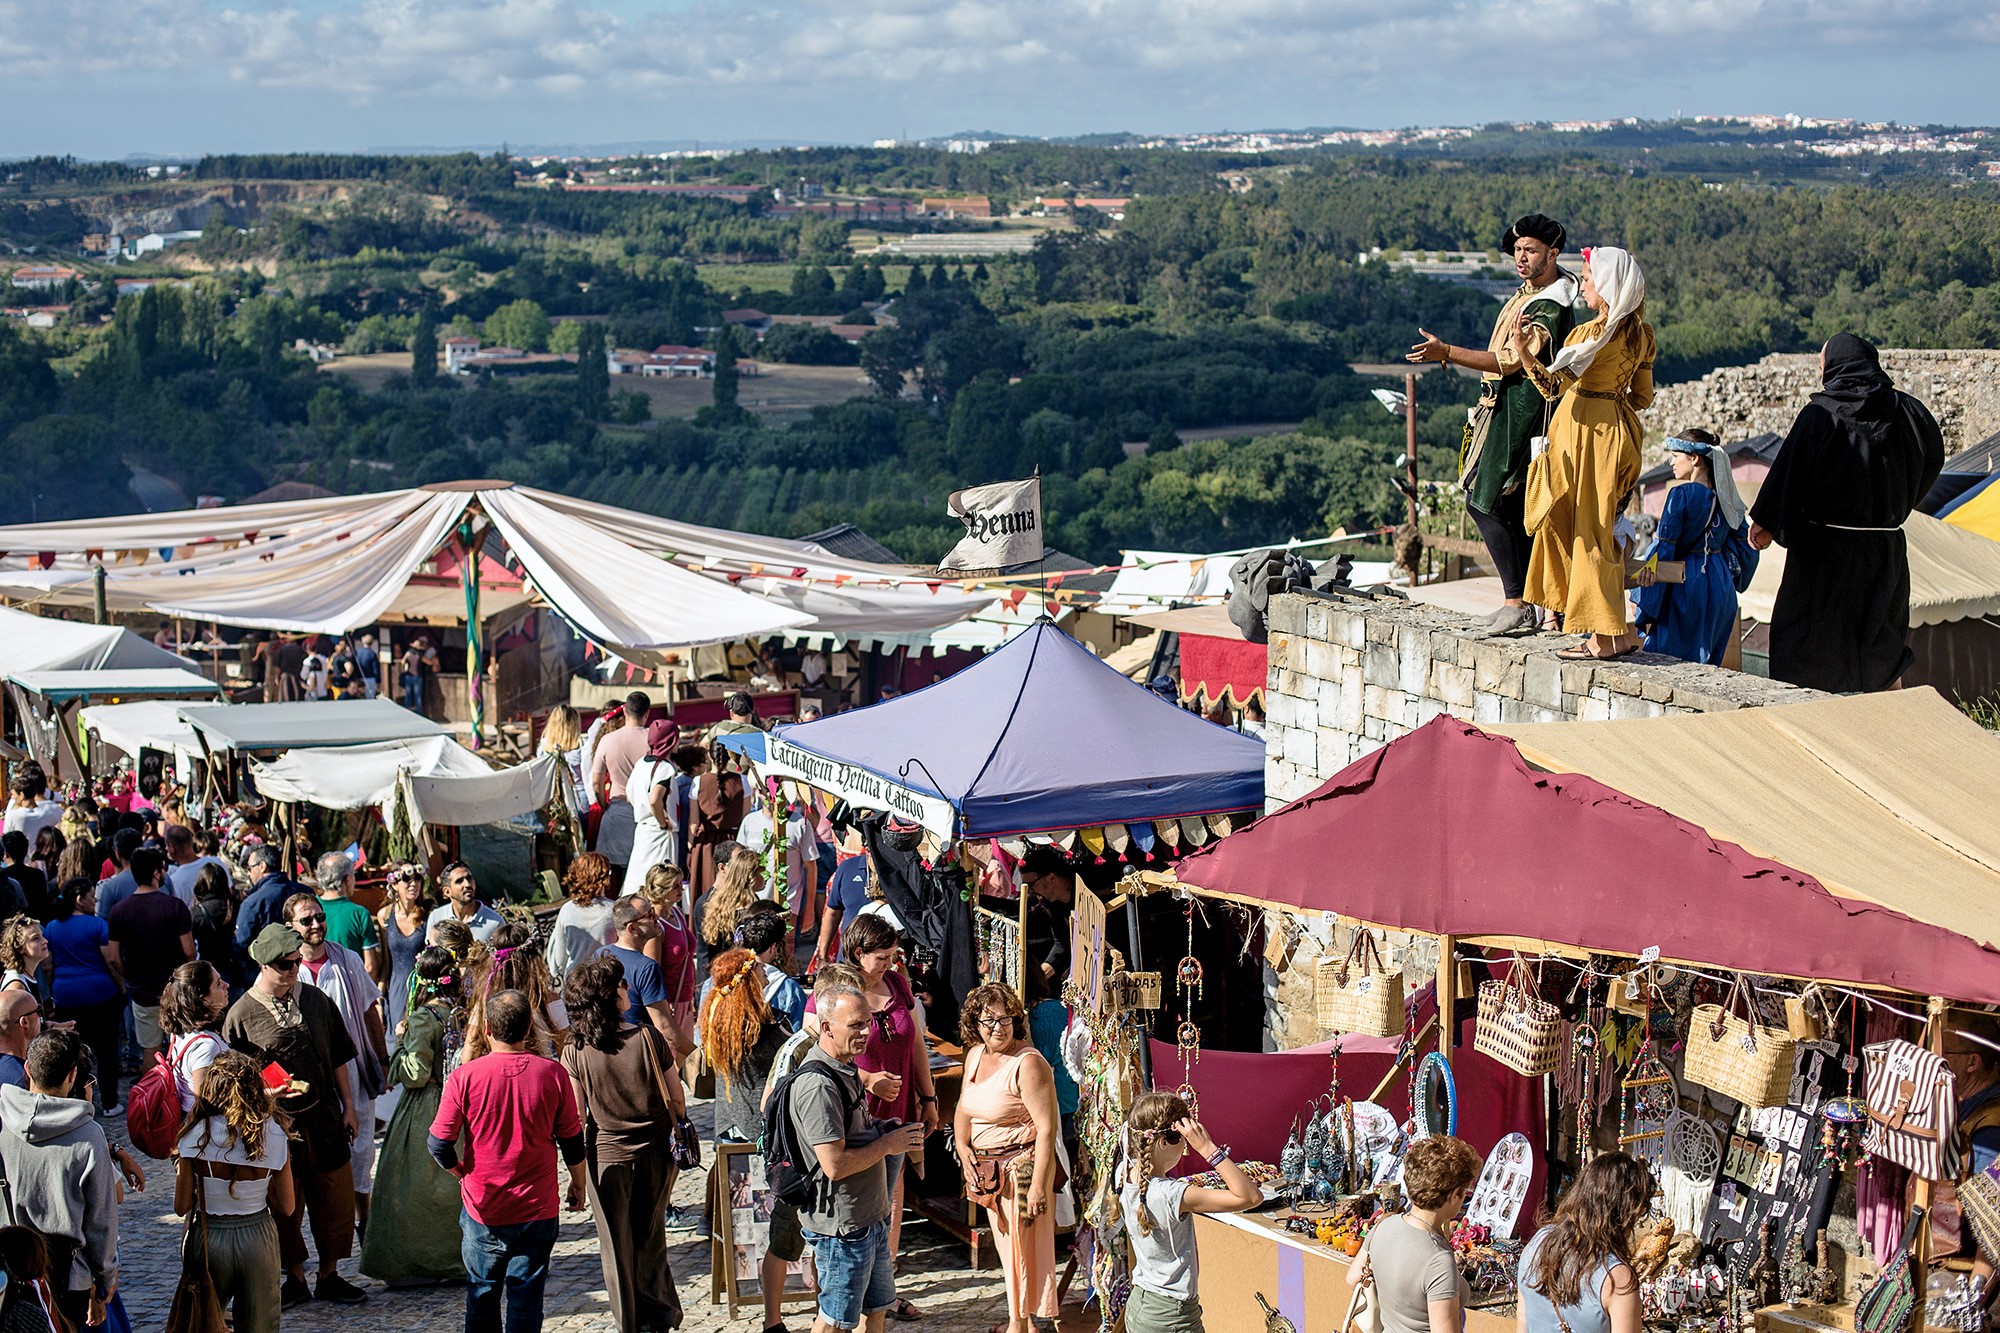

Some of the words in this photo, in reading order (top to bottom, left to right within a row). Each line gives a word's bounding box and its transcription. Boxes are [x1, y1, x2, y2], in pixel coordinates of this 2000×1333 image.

[962, 509, 1035, 543] Henna
[768, 737, 833, 781] Tatuagem
[836, 763, 881, 799] Henna
[884, 781, 924, 820] Tattoo
